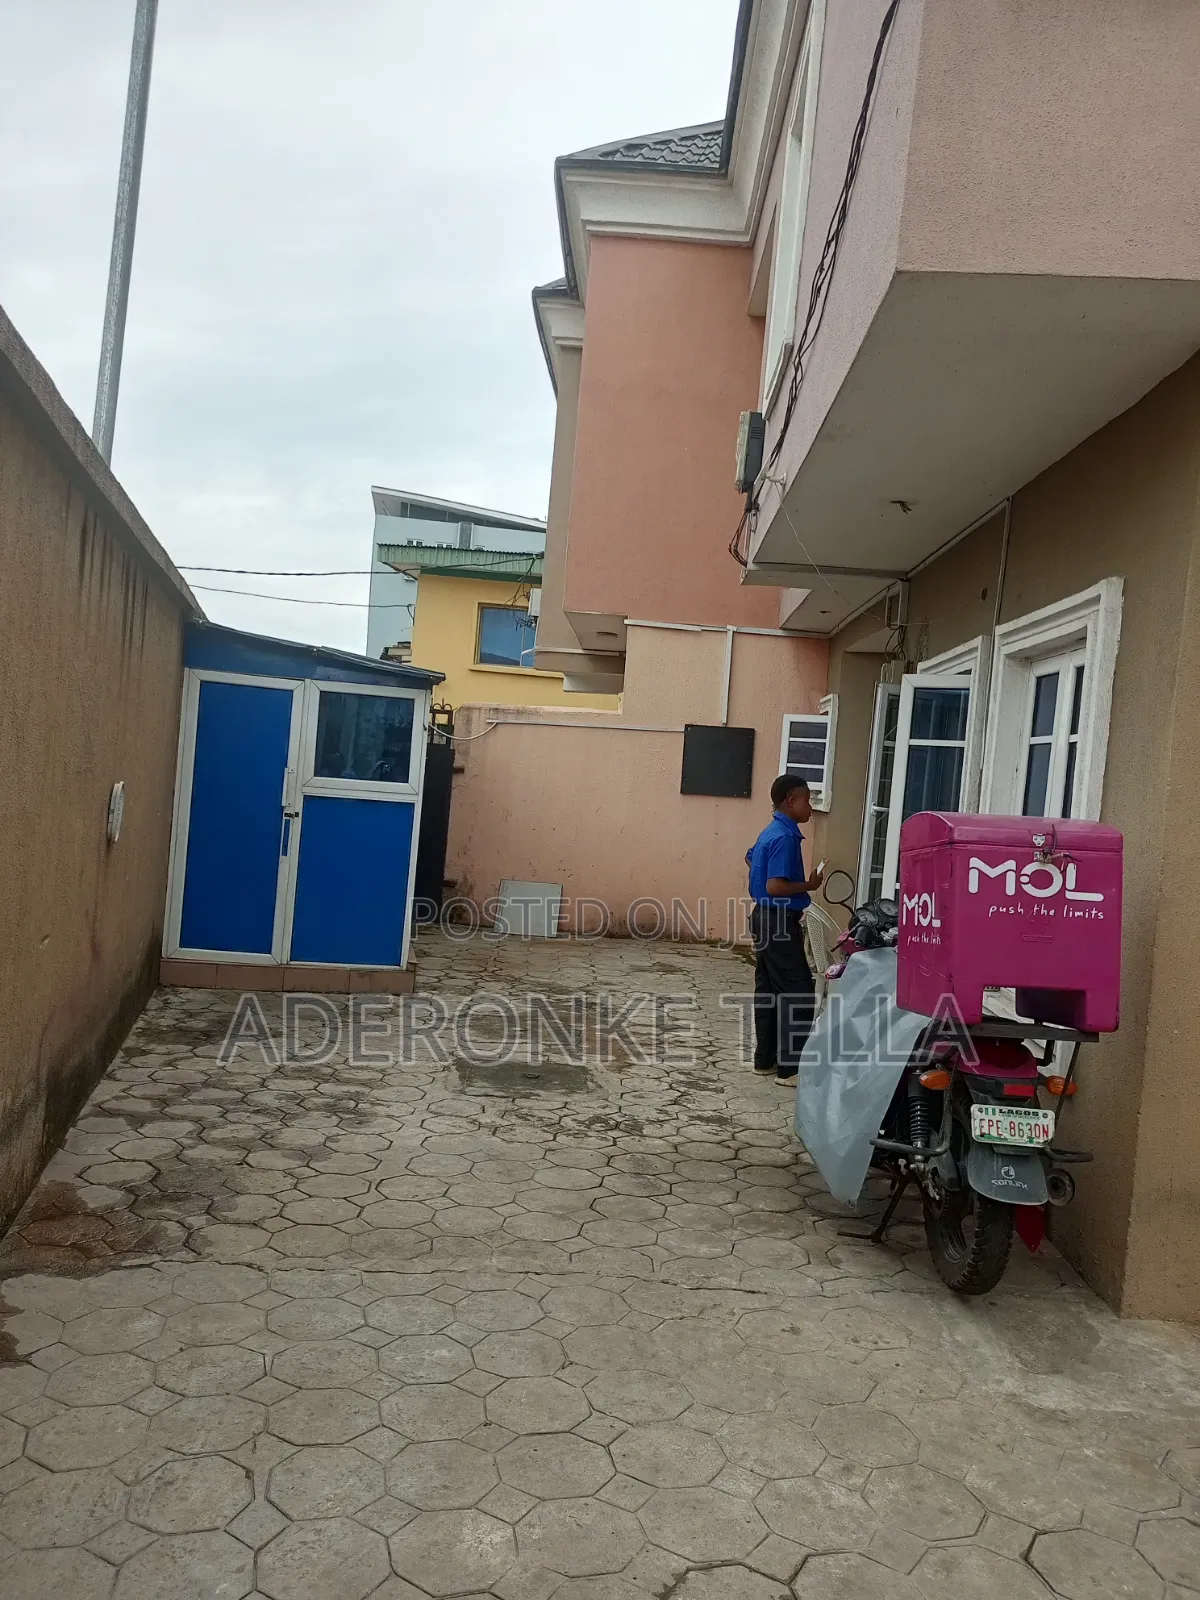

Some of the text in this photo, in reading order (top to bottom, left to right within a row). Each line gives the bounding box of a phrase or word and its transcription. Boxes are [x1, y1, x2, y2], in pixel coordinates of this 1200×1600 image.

[968, 856, 1104, 902] MOL
[902, 891, 942, 928] MOL
[988, 902, 1105, 920] push the limits
[998, 1108, 1039, 1116] LAGOS
